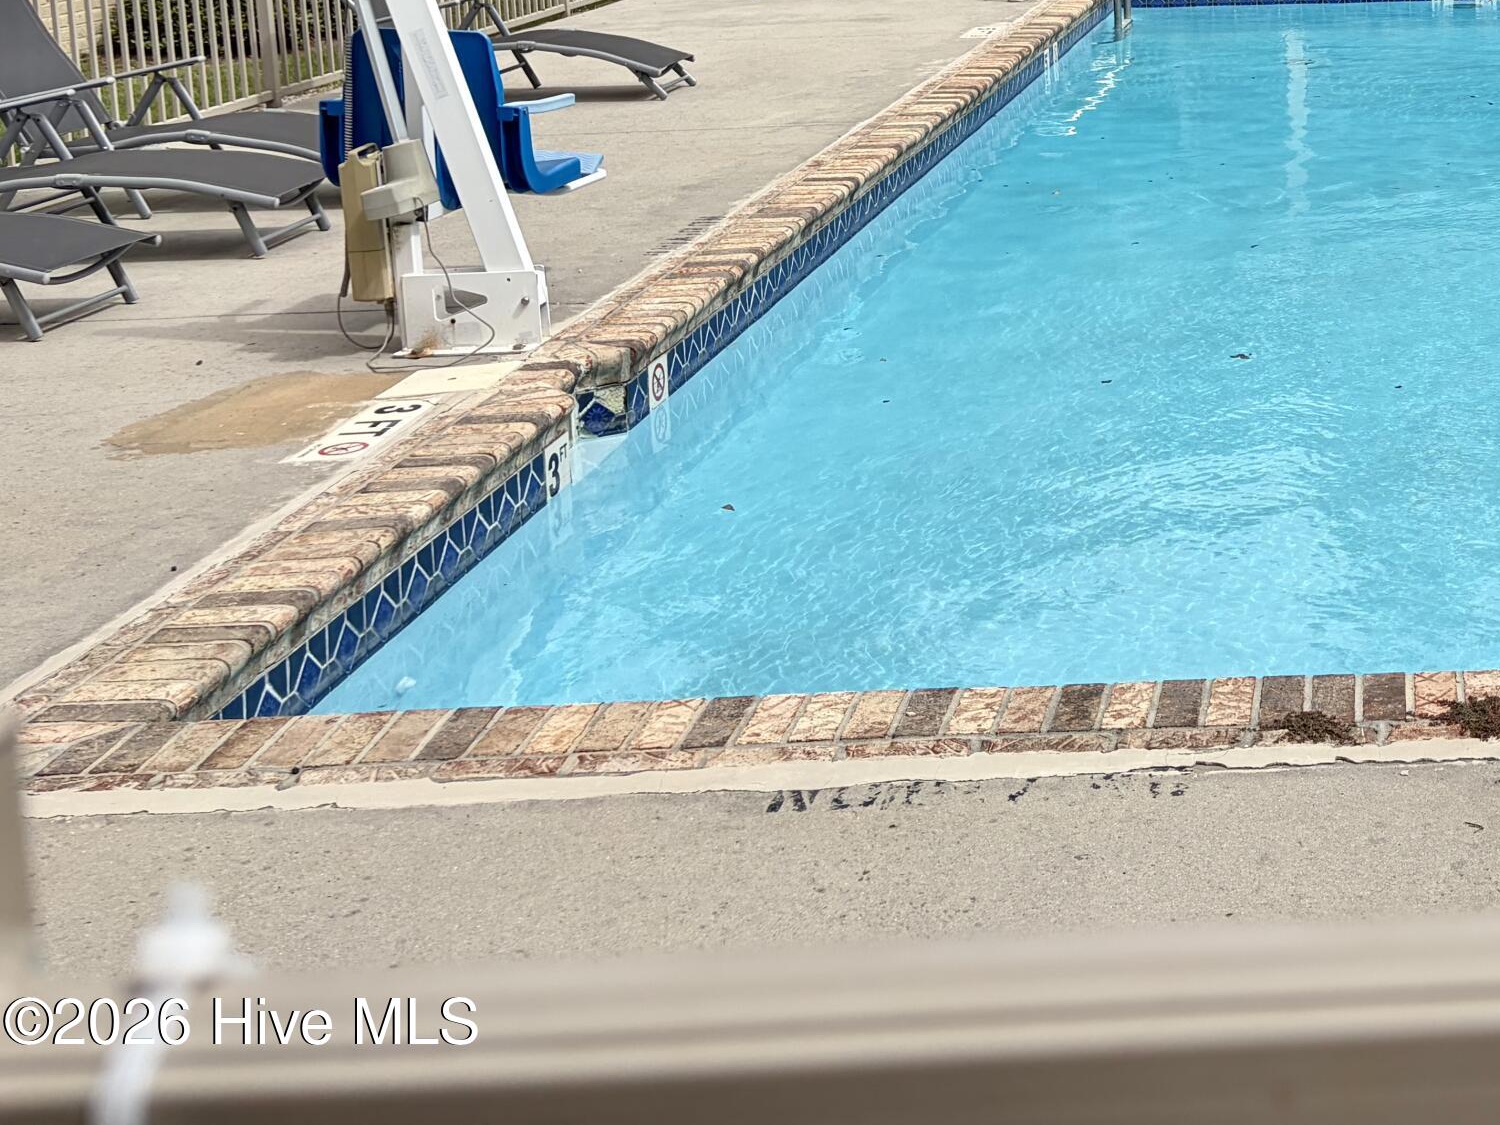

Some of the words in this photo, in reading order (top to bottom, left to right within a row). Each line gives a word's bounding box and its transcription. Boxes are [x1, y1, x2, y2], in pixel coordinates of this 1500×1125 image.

[374, 404, 422, 415] 3
[338, 419, 403, 437] FT
[548, 452, 561, 497] 3
[560, 443, 567, 463] FT
